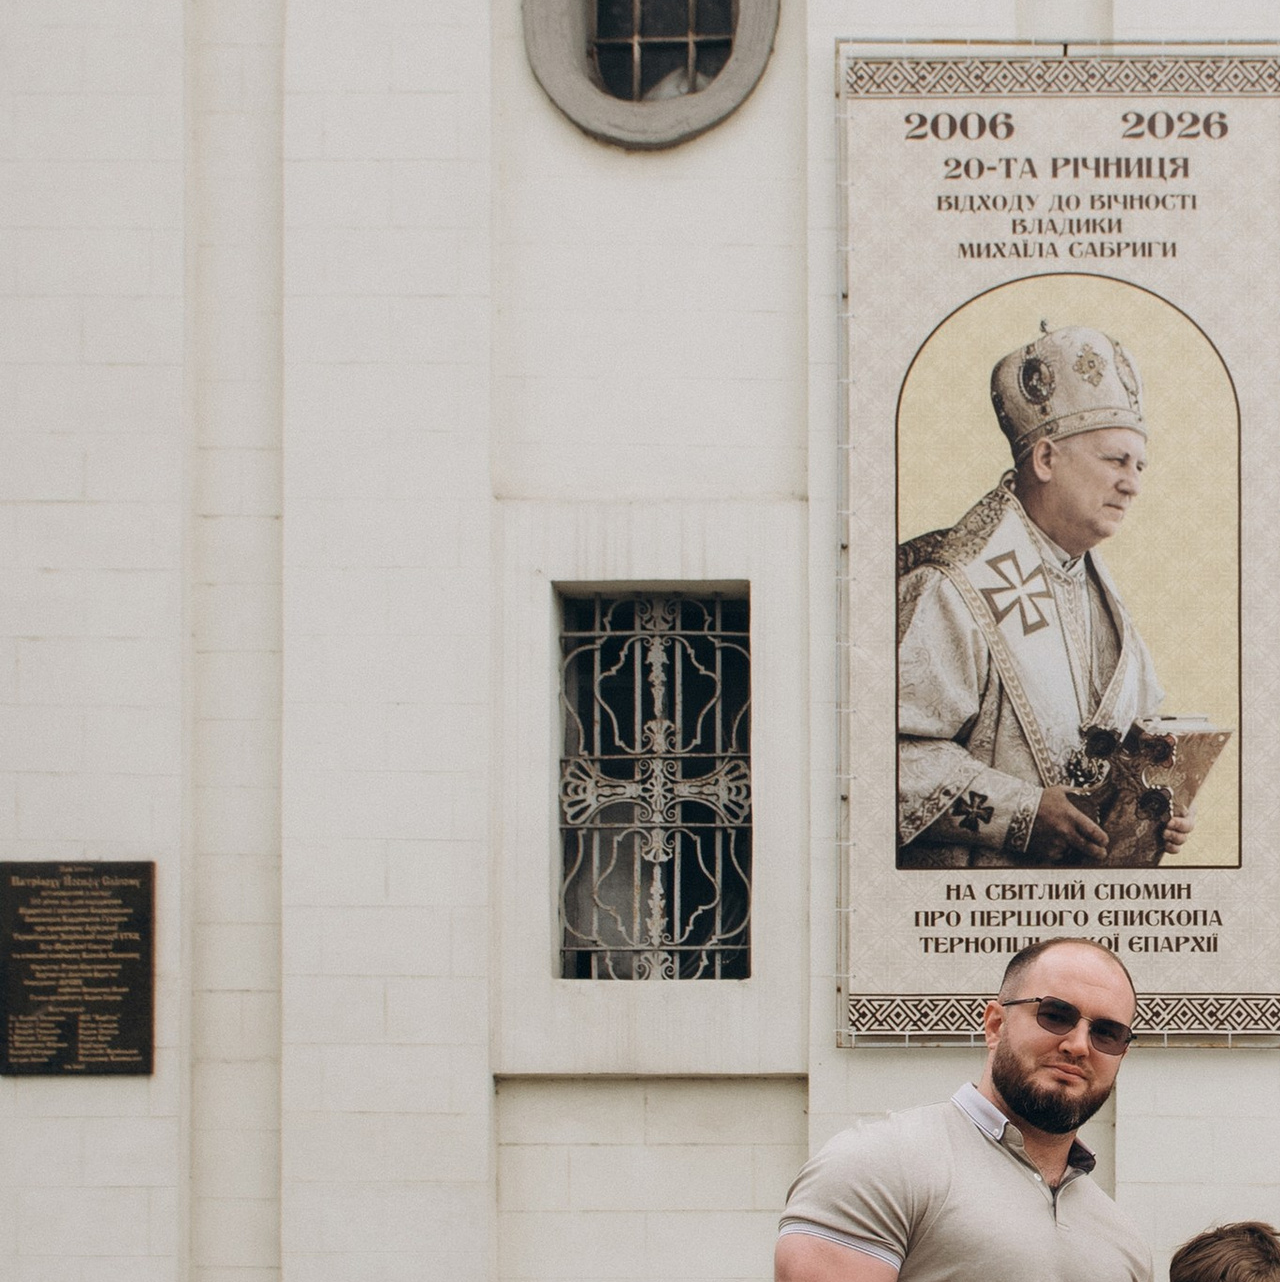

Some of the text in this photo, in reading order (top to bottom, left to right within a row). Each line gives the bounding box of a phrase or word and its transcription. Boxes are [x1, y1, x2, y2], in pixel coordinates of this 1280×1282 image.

[904, 111, 1229, 141] 2006 2026
[943, 156, 1190, 182] 20-ТА РІЧНИЦЯ
[936, 194, 1198, 214] ВІДХОДУ ДО ВІЧНОСТІ
[1011, 217, 1123, 236] ВЛАДИКИ
[957, 240, 1177, 259] МИХАЇЛА САБРИГИ
[945, 879, 1192, 901] НА СВІТЛИЙ СПОМИН
[914, 909, 1223, 928] ПРО ПЕРШОГО ЄПИСКОПА
[1127, 932, 1219, 954] ЄПАРХІЇ
